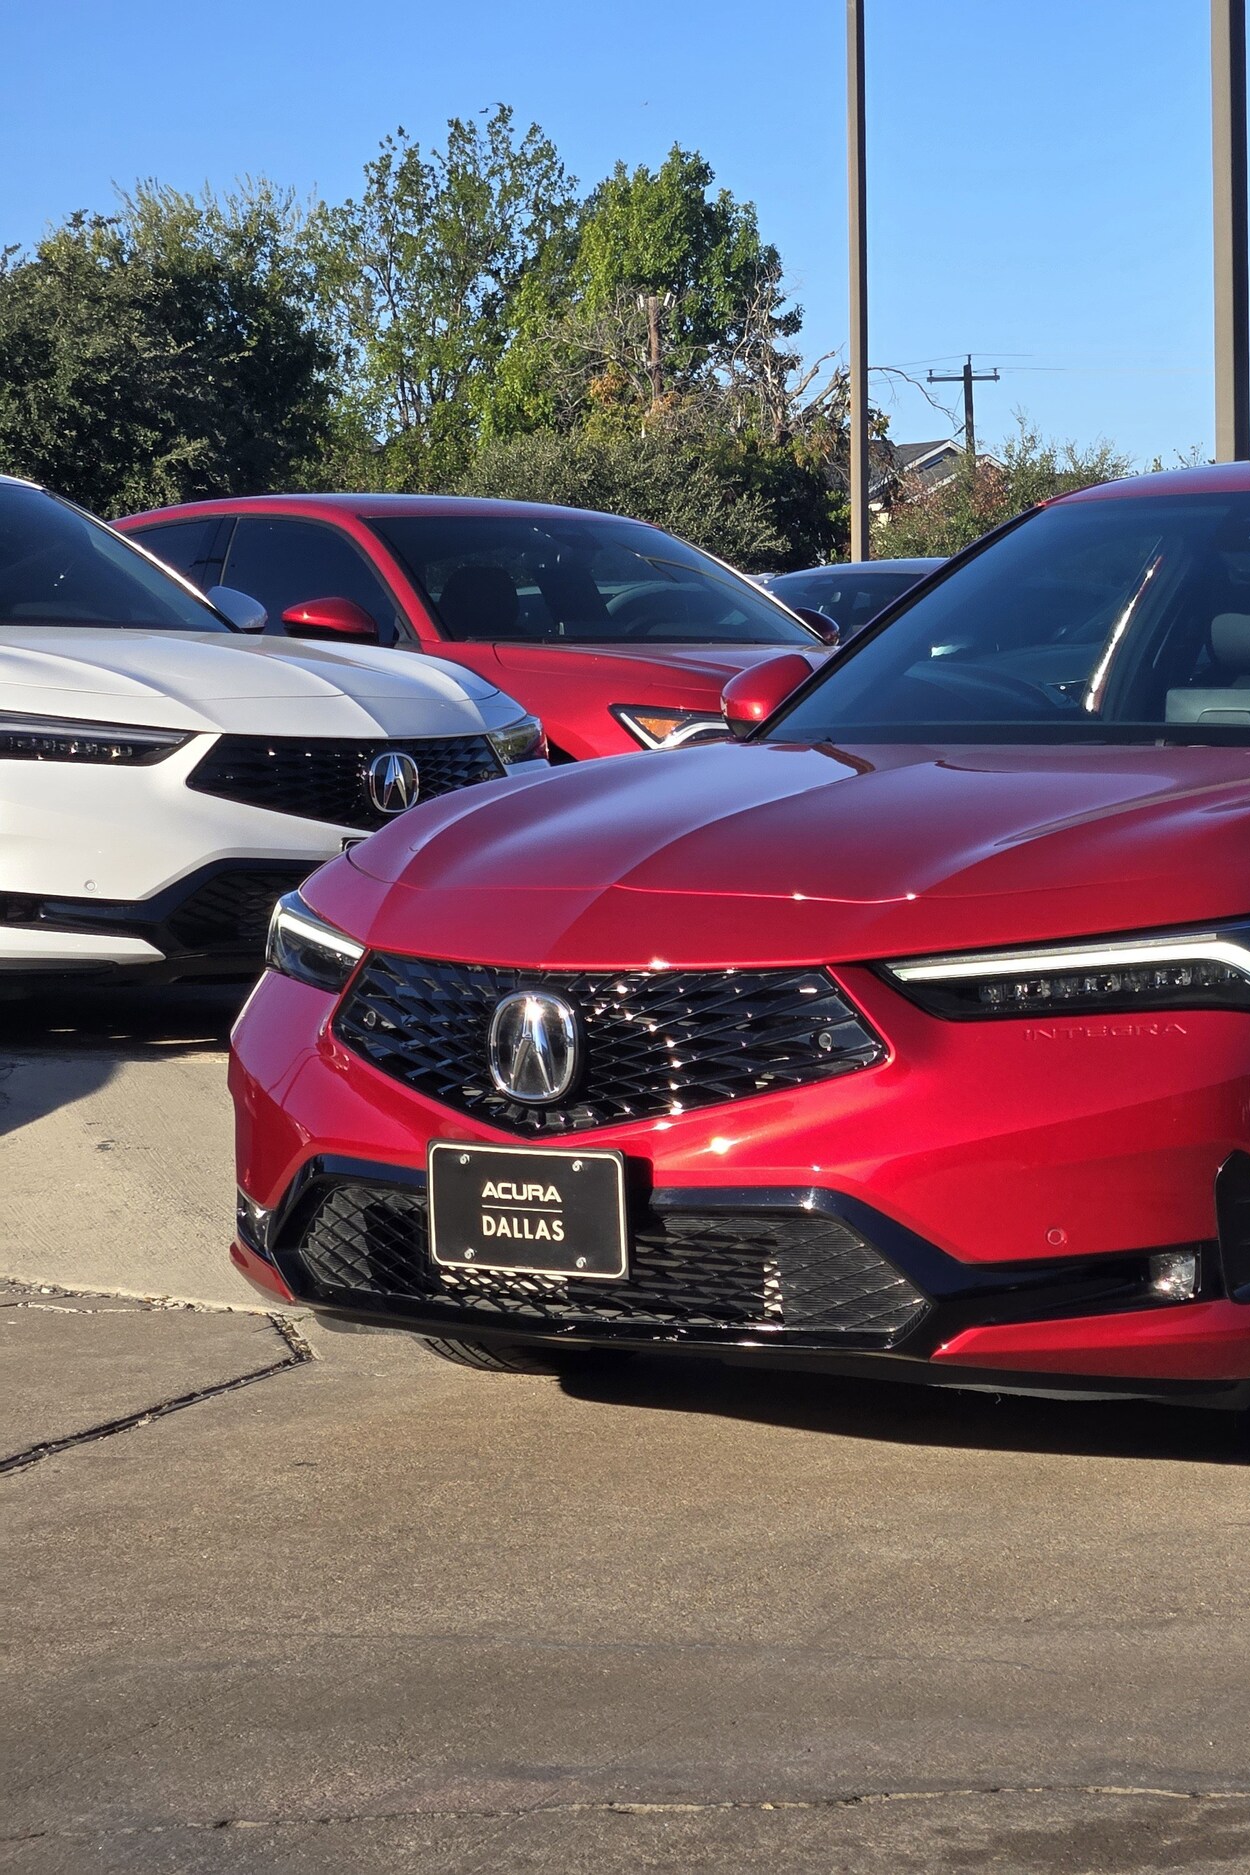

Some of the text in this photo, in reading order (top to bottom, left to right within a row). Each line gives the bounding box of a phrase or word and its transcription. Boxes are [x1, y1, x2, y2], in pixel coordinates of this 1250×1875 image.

[1025, 1023, 1187, 1041] INTEGRA
[482, 1181, 562, 1202] ACURA
[482, 1216, 565, 1241] DALLAS
